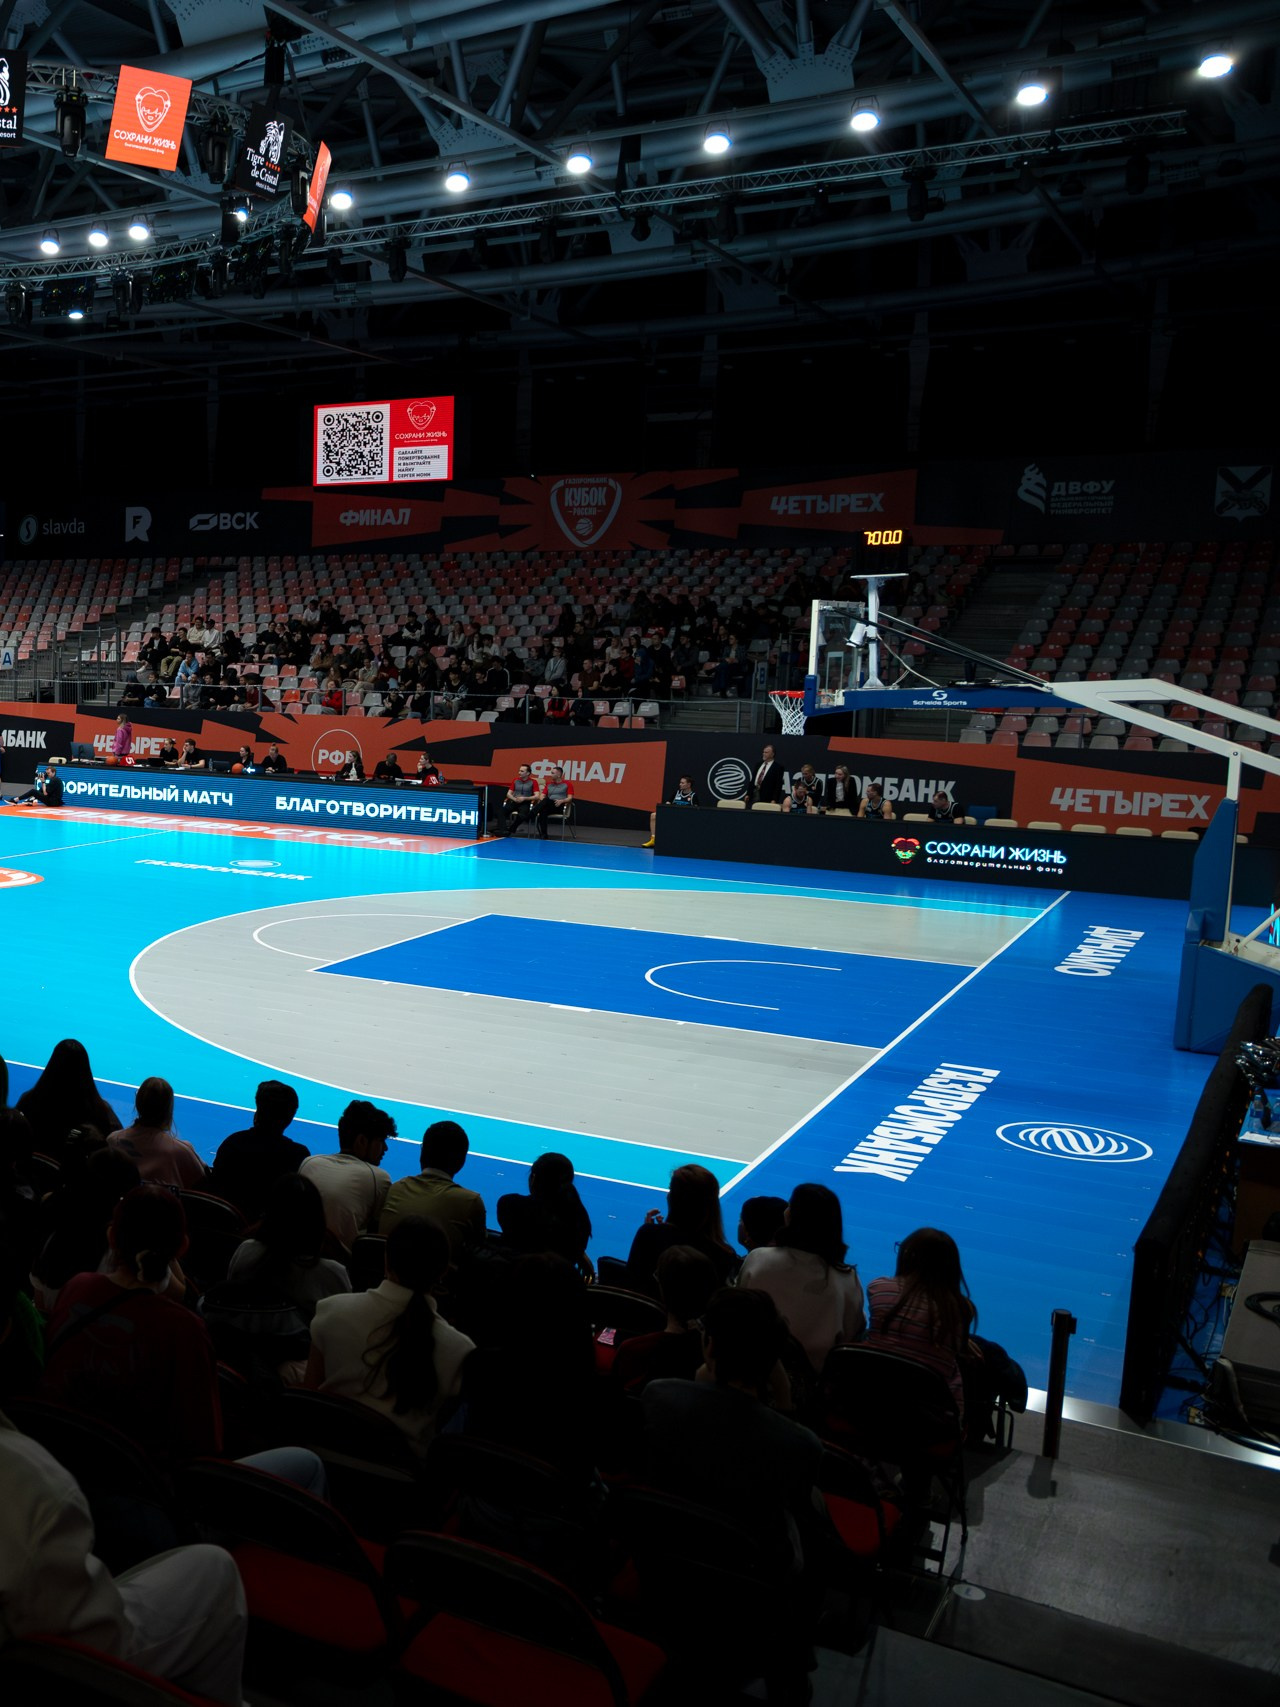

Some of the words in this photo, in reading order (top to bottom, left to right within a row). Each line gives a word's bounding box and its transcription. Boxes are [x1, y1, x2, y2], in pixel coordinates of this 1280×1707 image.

[113, 129, 152, 145] СОХРАНИ
[152, 137, 176, 150] ЖИЗНЬ
[246, 147, 265, 166] Tigre
[251, 166, 260, 178] de
[260, 168, 280, 186] Cristal
[395, 432, 425, 440] СОХРАНИ
[564, 487, 607, 507] КУБОК
[1051, 480, 1116, 496] ДВФУ
[769, 492, 886, 516] ЧЕТЫРЕХ
[42, 517, 86, 536] slavda
[219, 511, 259, 531] ВСК
[339, 508, 411, 527] ФИНАЛ
[93, 734, 176, 755] ЧЕЫРЕ
[530, 758, 627, 784] ФИНАЛ
[59, 780, 179, 802] ОРИТЕЛЬНЫЙ
[183, 789, 233, 807] МАТЧ
[1049, 787, 1211, 820] ЧЕТЫРЕХ
[17, 807, 424, 847] ВЛАДИВОСТОК
[925, 841, 1005, 860] СОХРАНИ
[1008, 847, 1067, 864] ЖИЗНЬ
[927, 856, 1032, 872] благотворительный
[1036, 865, 1064, 875] фонд
[1053, 925, 1146, 977] ДИНАМО
[833, 1062, 1001, 1182] ГАЗПРОМБАНК
